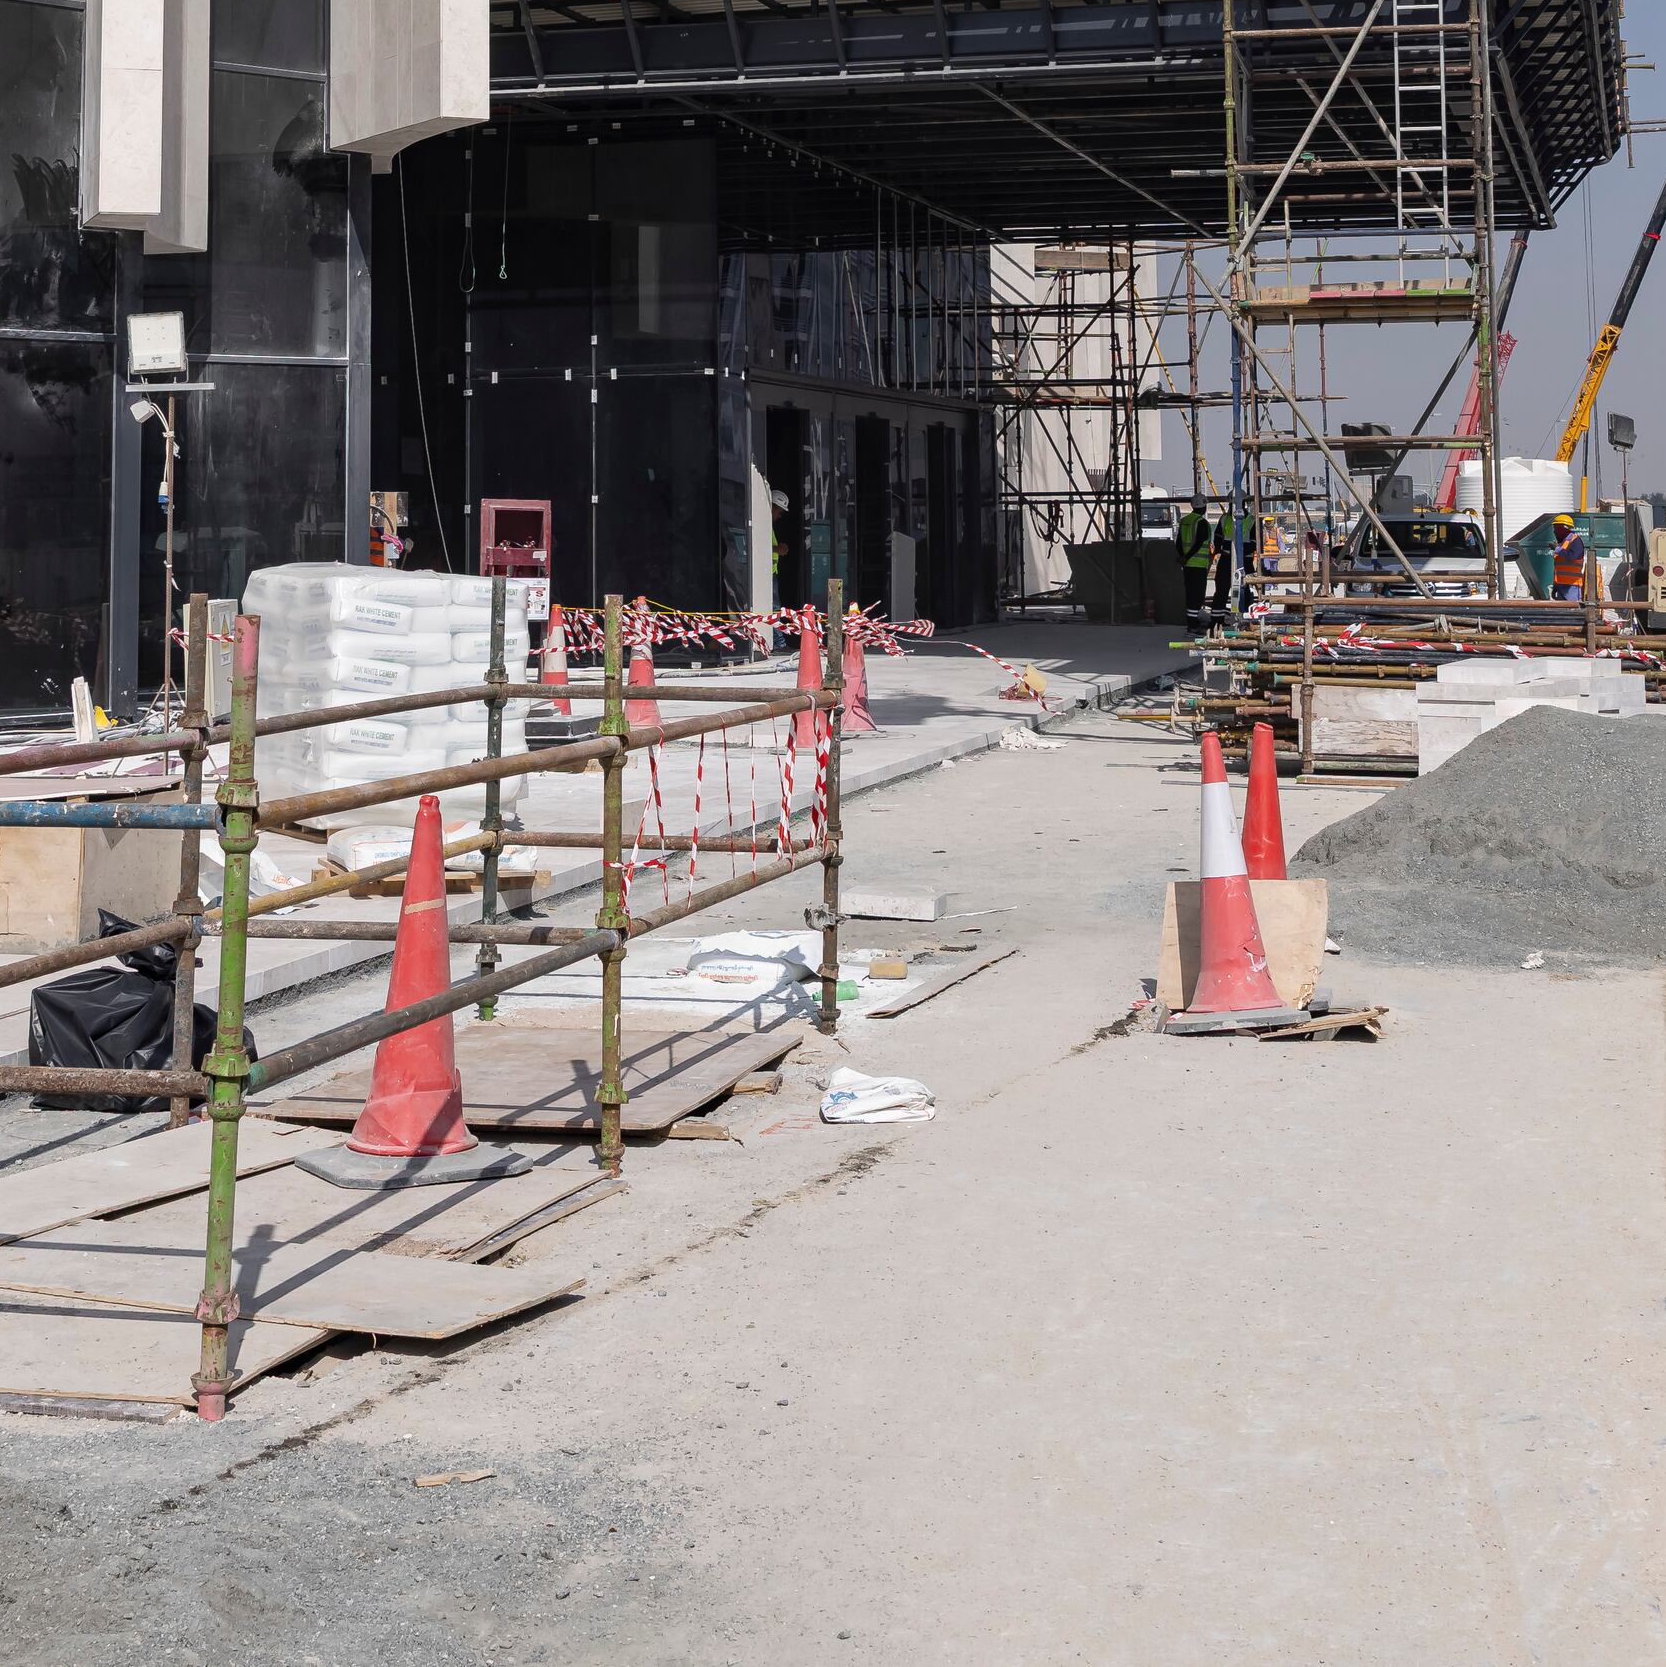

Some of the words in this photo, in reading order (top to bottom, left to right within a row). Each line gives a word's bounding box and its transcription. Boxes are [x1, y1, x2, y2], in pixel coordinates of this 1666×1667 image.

[366, 607, 381, 616] WHITE
[382, 610, 401, 619] CEMENT
[364, 667, 379, 677] WHITE
[379, 669, 398, 679] CEMENT
[361, 730, 375, 739] WHITE
[375, 731, 395, 741] CEMENT
